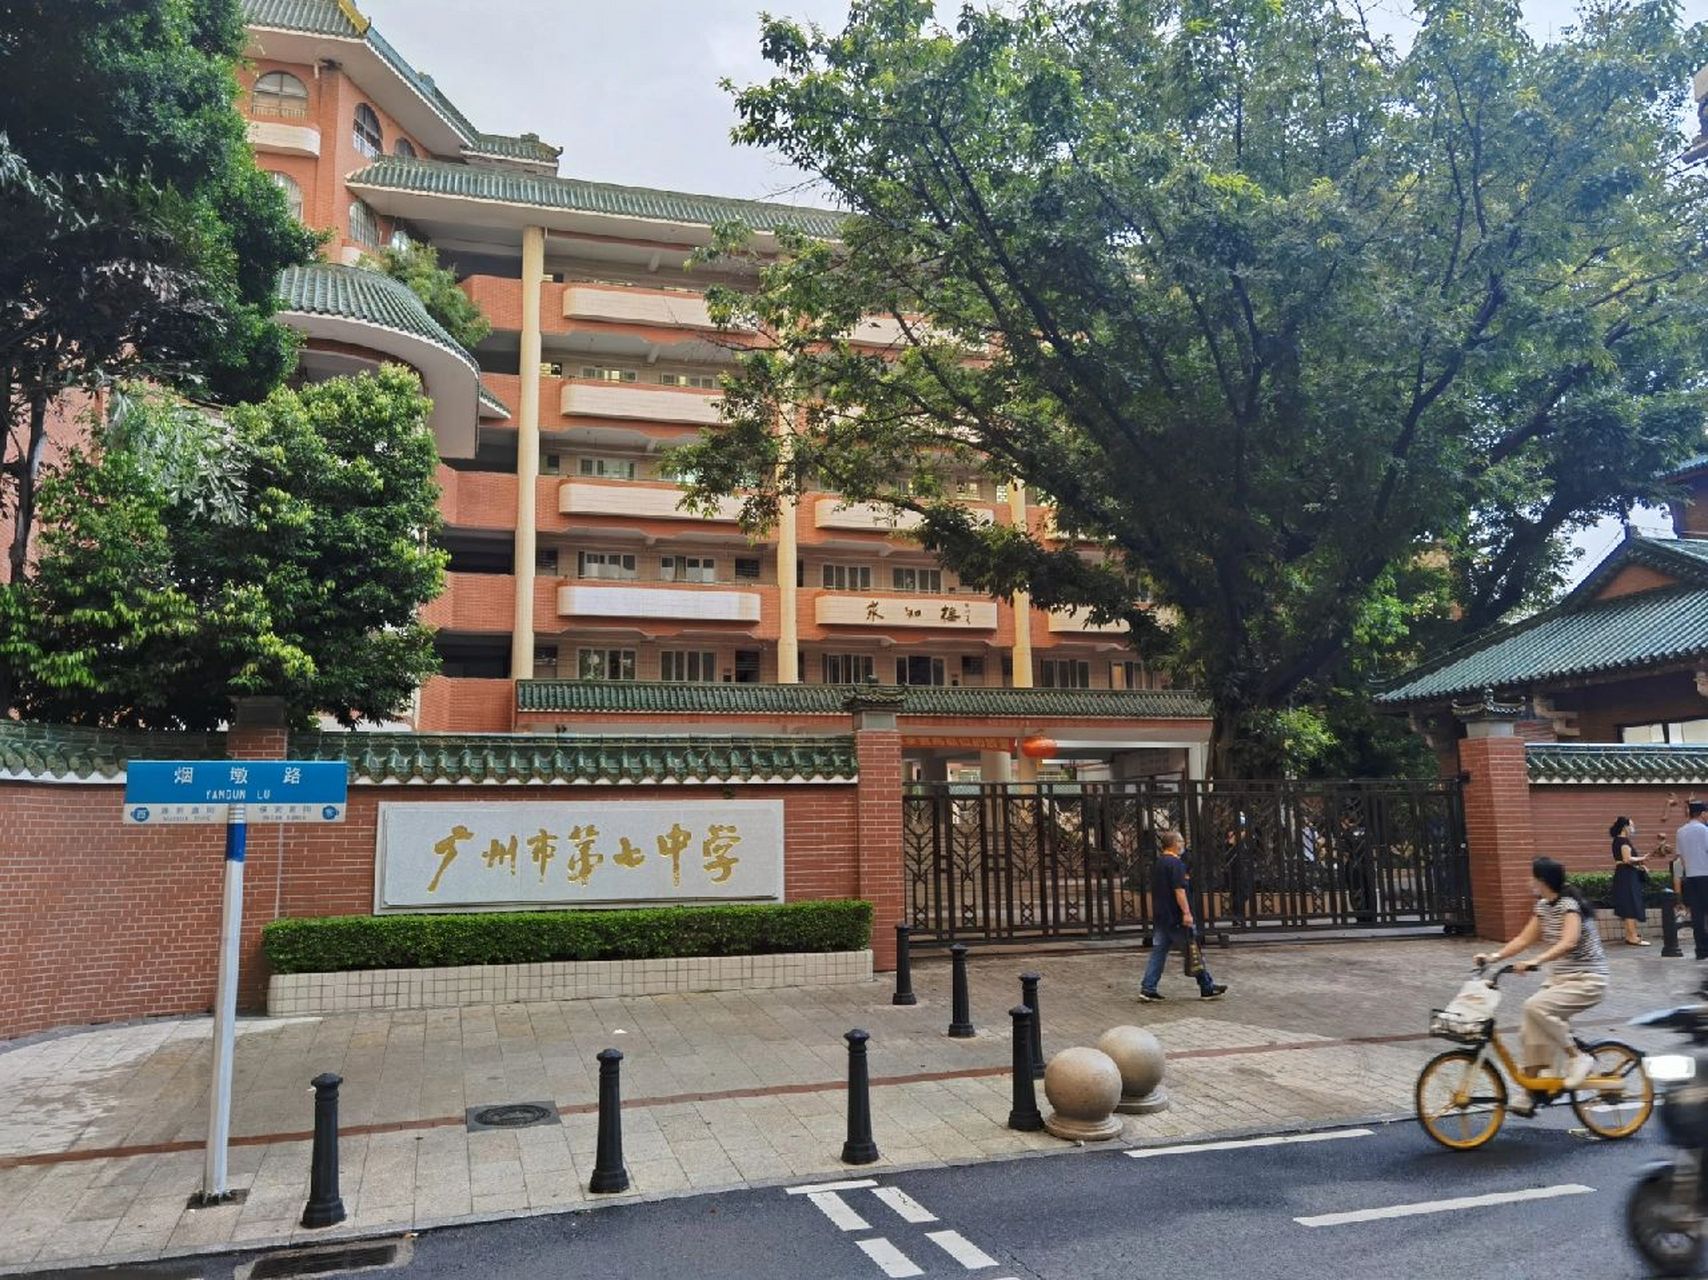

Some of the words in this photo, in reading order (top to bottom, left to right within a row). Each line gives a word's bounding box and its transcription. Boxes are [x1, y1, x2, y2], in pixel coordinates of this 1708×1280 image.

[173, 766, 302, 785] 烟墩路
[205, 789, 246, 800] YANDUN
[256, 789, 271, 800] LU
[426, 822, 742, 893] 广州市第七中学
